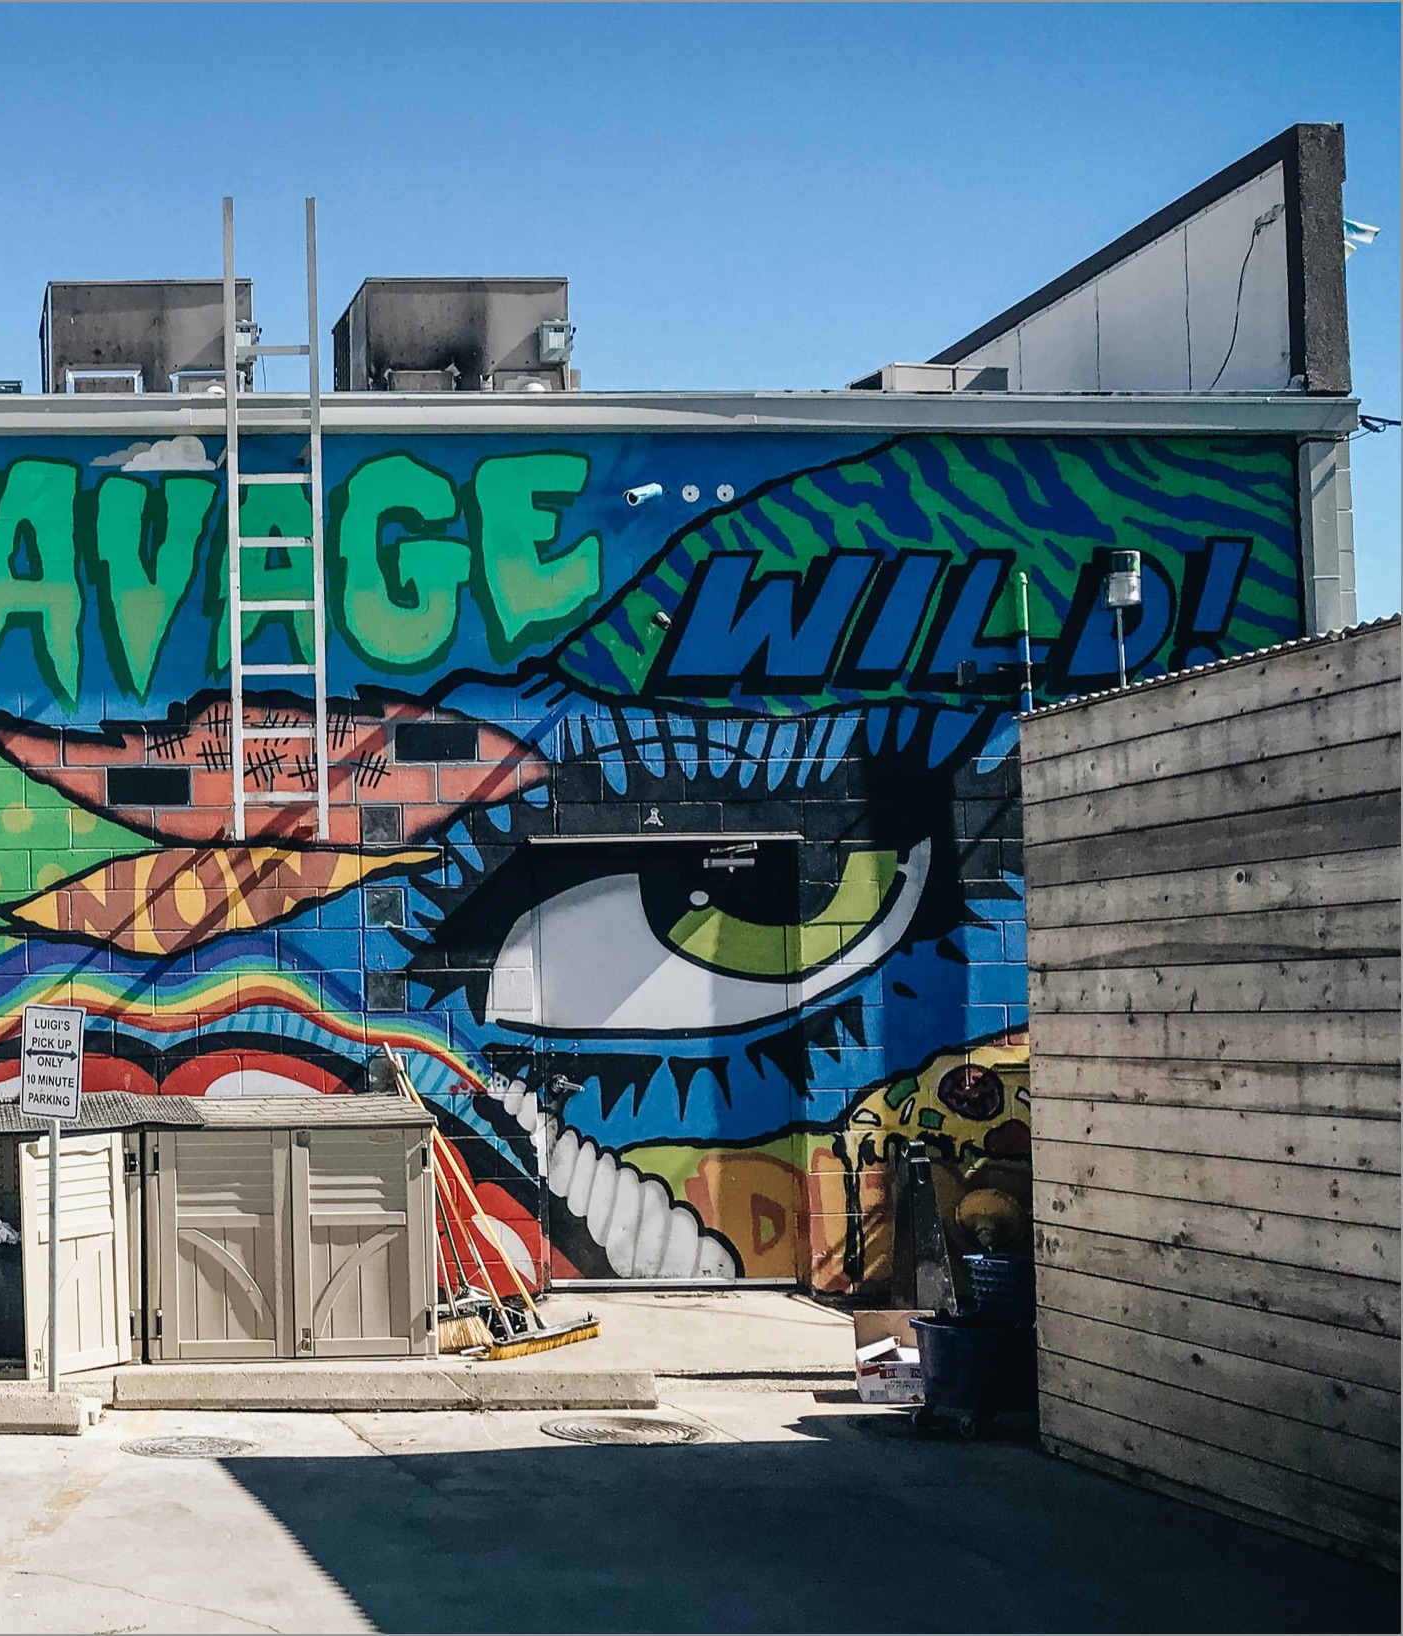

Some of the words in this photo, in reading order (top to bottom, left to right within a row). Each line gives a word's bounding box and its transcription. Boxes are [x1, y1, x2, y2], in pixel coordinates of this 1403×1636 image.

[647, 537, 1252, 695] WILD!
[57, 849, 341, 954] NOW
[34, 1019, 71, 1031] LUIGI'S
[31, 1037, 55, 1049] PICK
[57, 1039, 72, 1050] UP
[37, 1056, 64, 1068] ONLY
[26, 1074, 36, 1084] 10
[38, 1075, 75, 1088] MINUTE
[28, 1092, 70, 1107] PARKING
